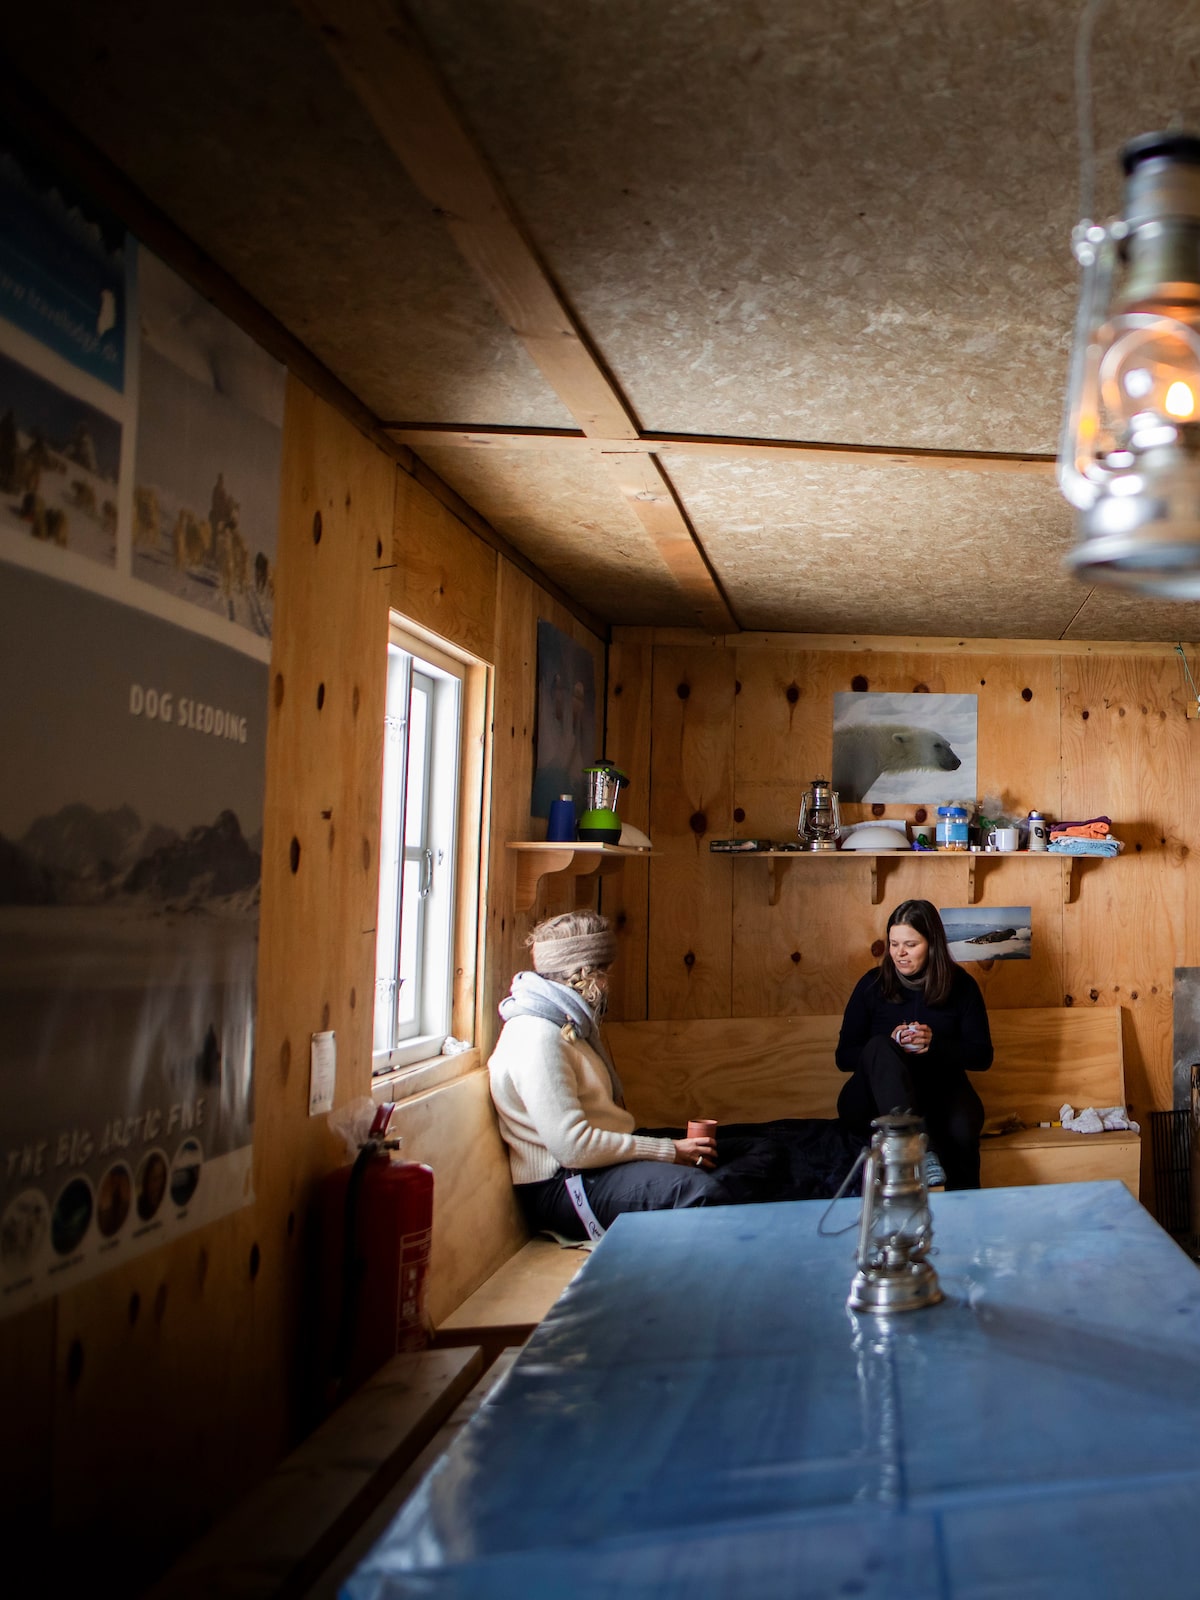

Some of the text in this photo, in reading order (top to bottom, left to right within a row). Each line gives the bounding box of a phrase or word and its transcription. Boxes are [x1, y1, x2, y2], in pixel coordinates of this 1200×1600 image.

[129, 683, 248, 744] DOG SLEDDING
[7, 1141, 48, 1177] THE
[56, 1128, 94, 1167] BIG
[101, 1108, 162, 1156] ARCTIC
